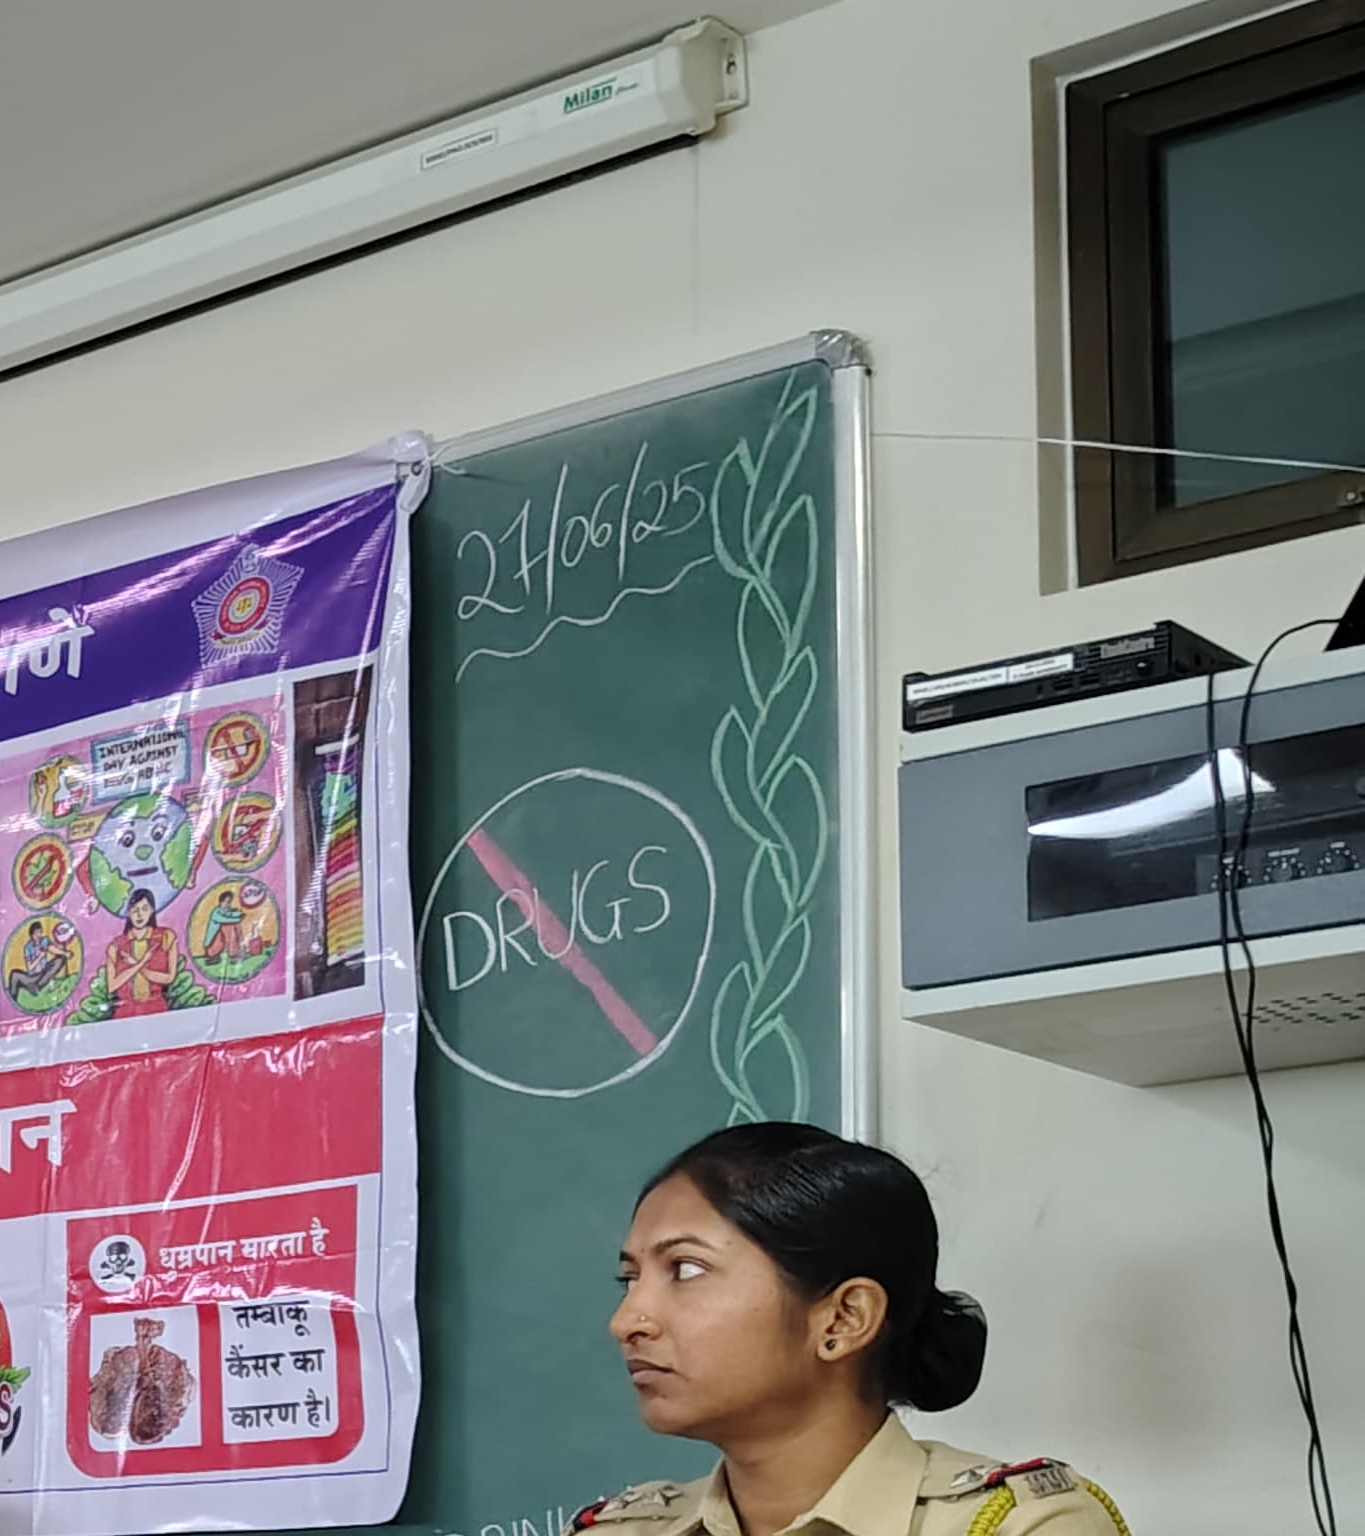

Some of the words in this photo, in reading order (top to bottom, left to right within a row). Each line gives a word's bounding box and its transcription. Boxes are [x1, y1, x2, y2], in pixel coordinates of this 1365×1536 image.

[563, 84, 614, 114] Milan
[442, 845, 671, 993] DRUGS
[240, 1231, 307, 1261] मारता
[309, 1216, 330, 1257] है
[224, 1343, 286, 1380] कैंसर
[289, 1348, 326, 1374] का
[227, 1402, 300, 1430] कारण
